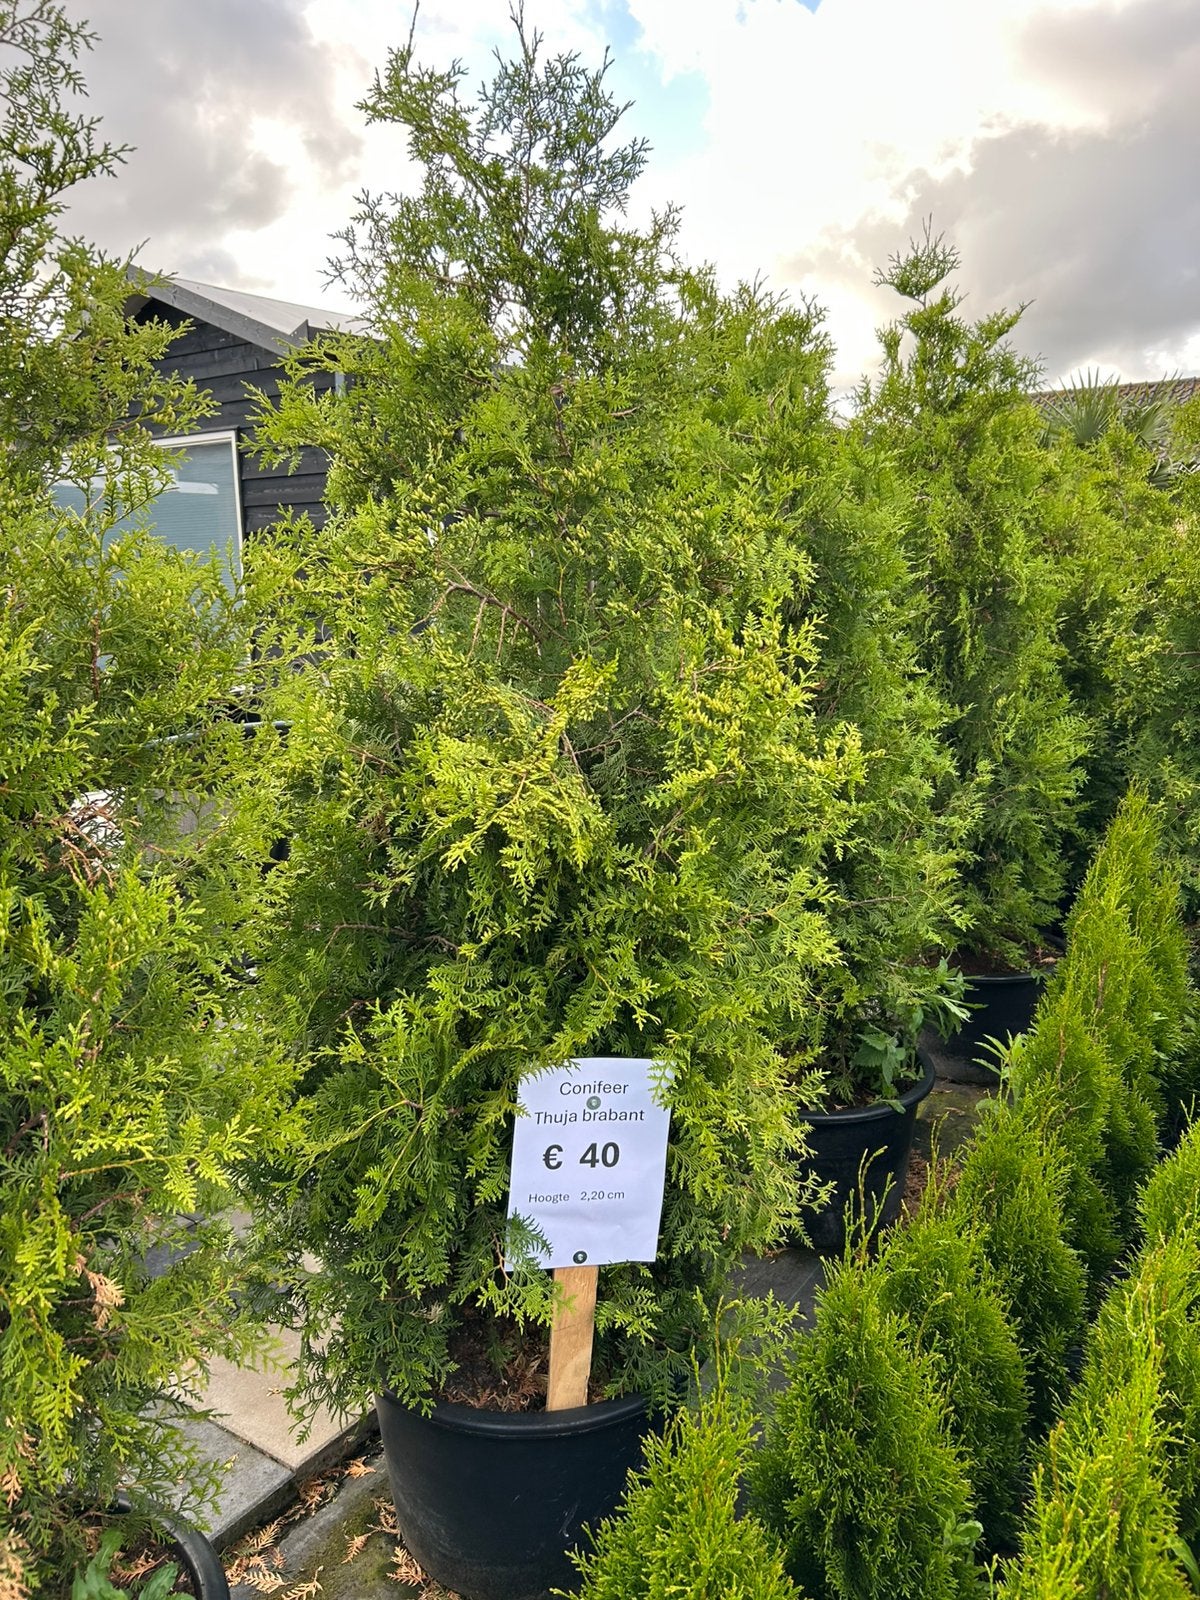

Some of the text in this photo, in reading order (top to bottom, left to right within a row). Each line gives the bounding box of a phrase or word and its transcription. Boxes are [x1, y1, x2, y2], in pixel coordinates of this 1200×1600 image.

[559, 1080, 629, 1096] Conifeer
[534, 1108, 645, 1126] Thuja brabant
[542, 1142, 620, 1170] € 40
[528, 1190, 625, 1204] Hoogte 2,20 cm
